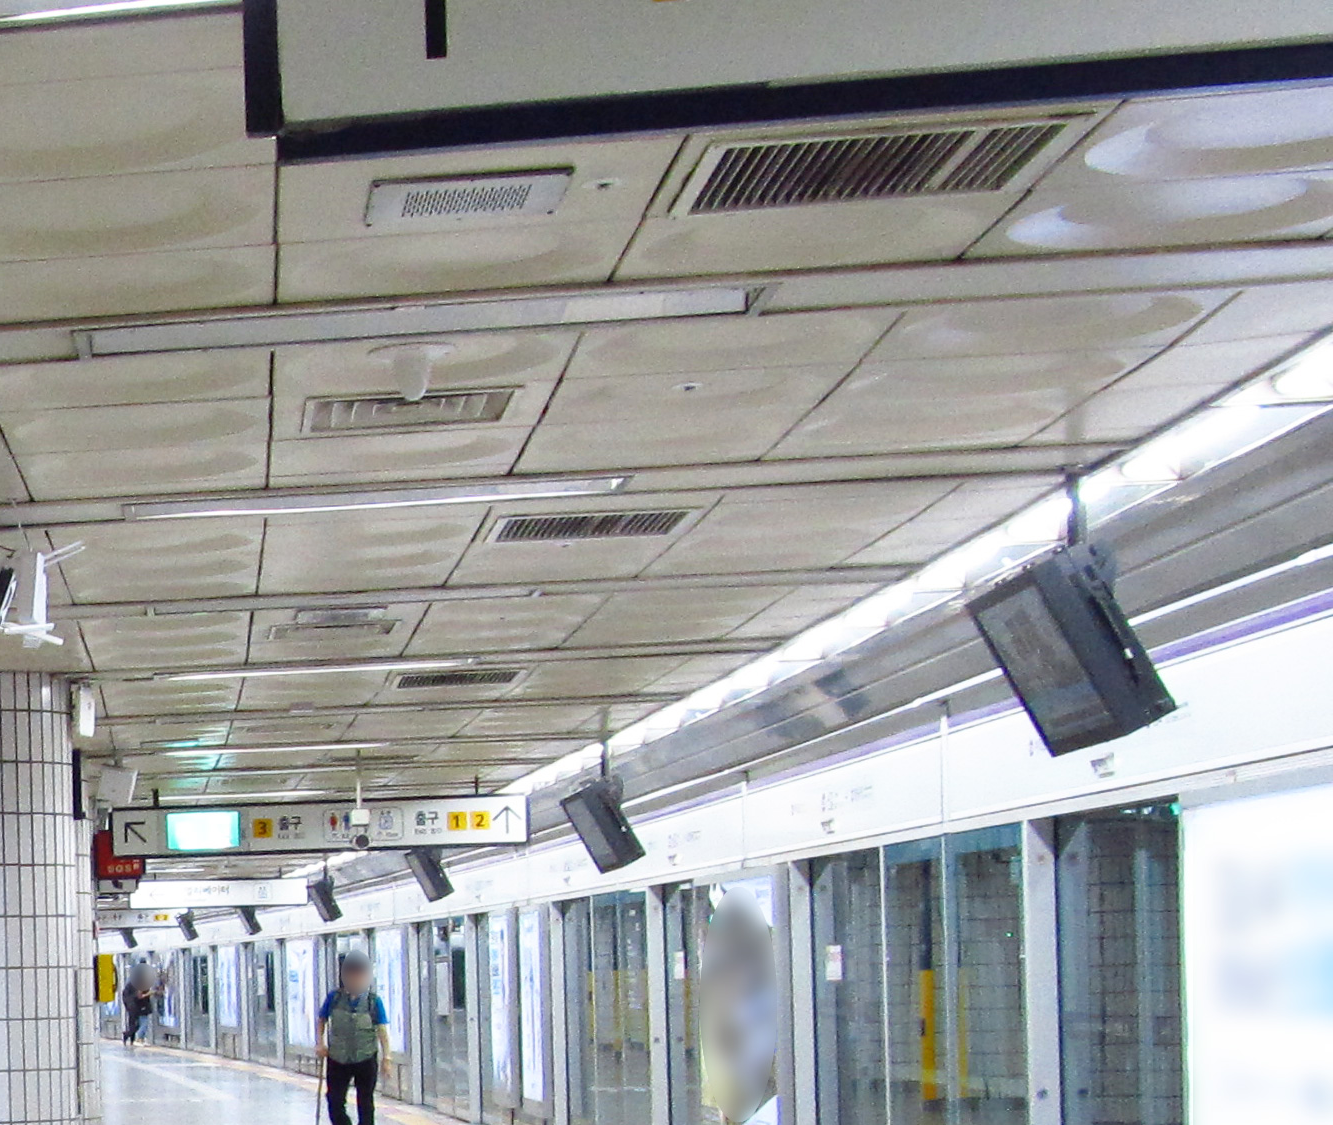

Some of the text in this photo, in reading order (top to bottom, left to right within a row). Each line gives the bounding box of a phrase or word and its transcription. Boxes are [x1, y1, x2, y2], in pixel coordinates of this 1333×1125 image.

[277, 815, 303, 831] 출구
[415, 810, 440, 827] 출구
[257, 821, 267, 835] 3
